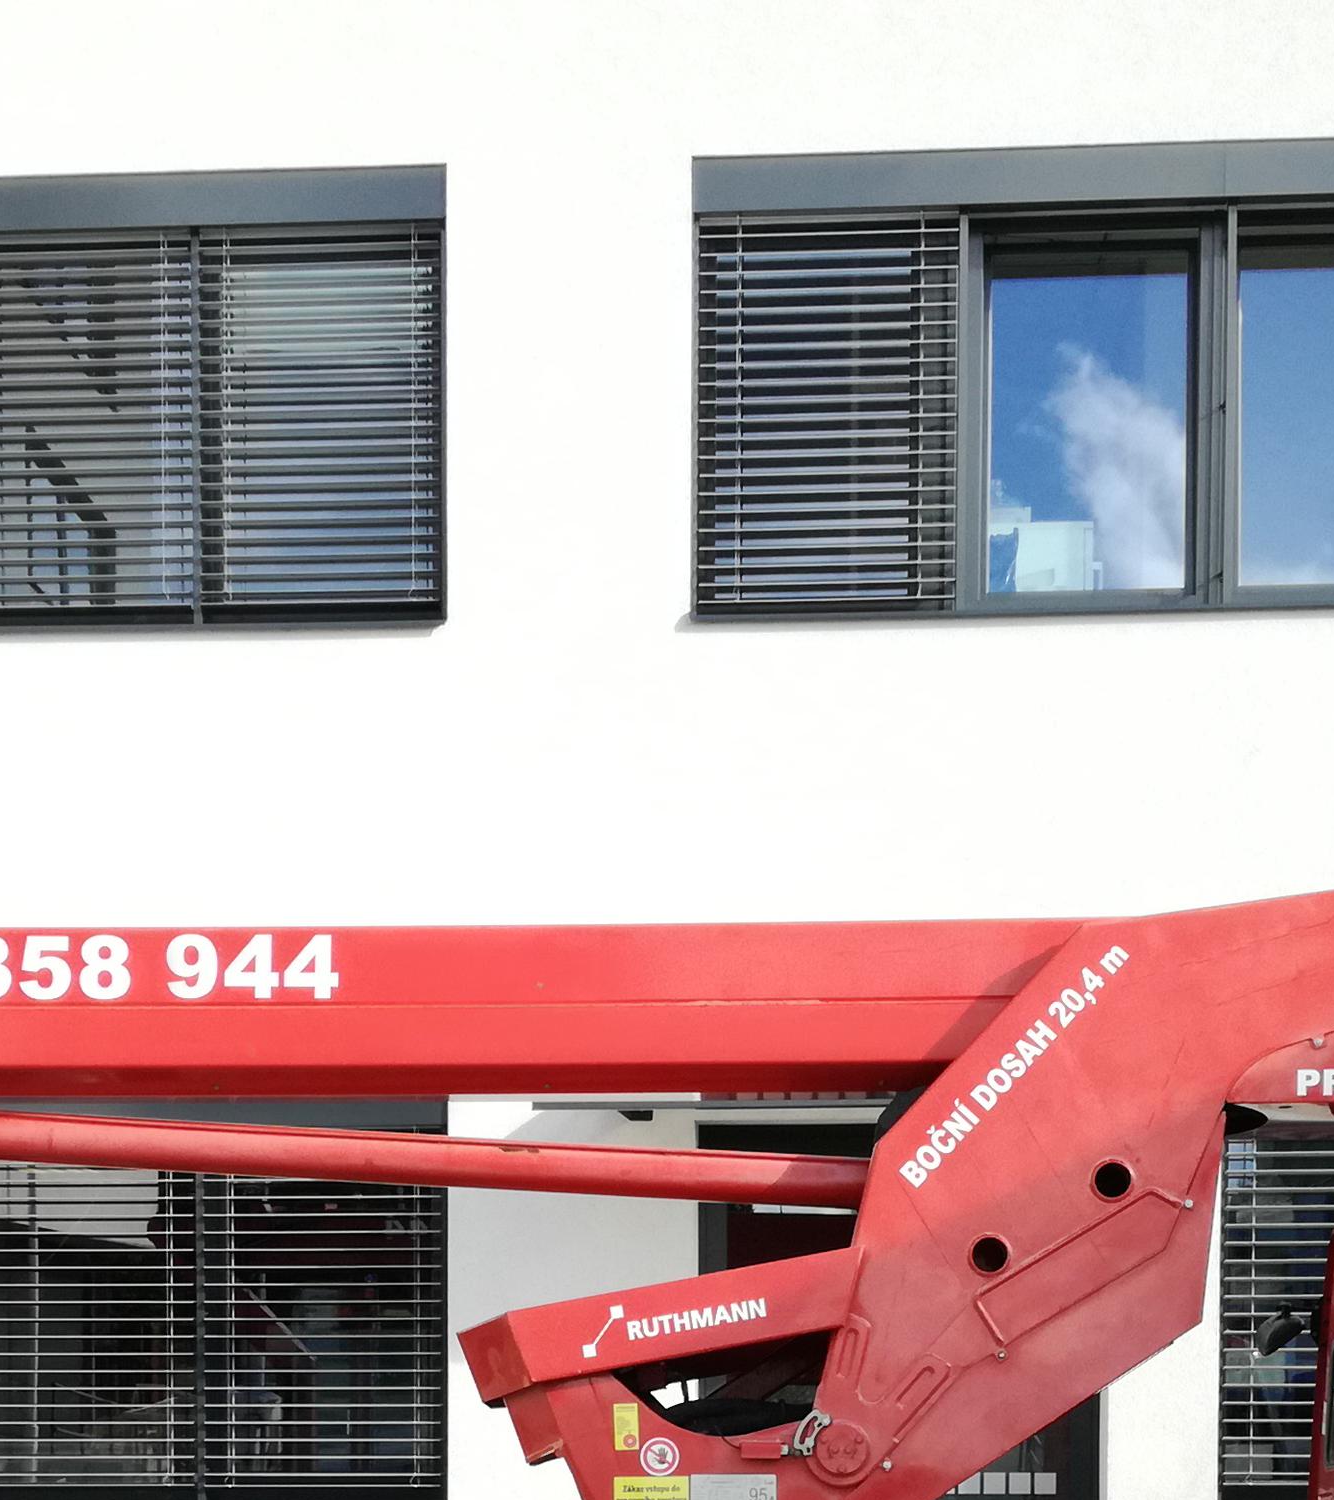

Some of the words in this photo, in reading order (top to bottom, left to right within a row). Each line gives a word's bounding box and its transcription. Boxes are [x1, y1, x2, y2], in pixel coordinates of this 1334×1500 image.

[165, 933, 339, 1000] 944
[898, 1097, 981, 1189] BOČNÍ
[969, 1018, 1059, 1112] DOSAH
[1047, 966, 1106, 1029] 20,4
[1099, 944, 1130, 975] m
[626, 1297, 768, 1341] RUTHMANN
